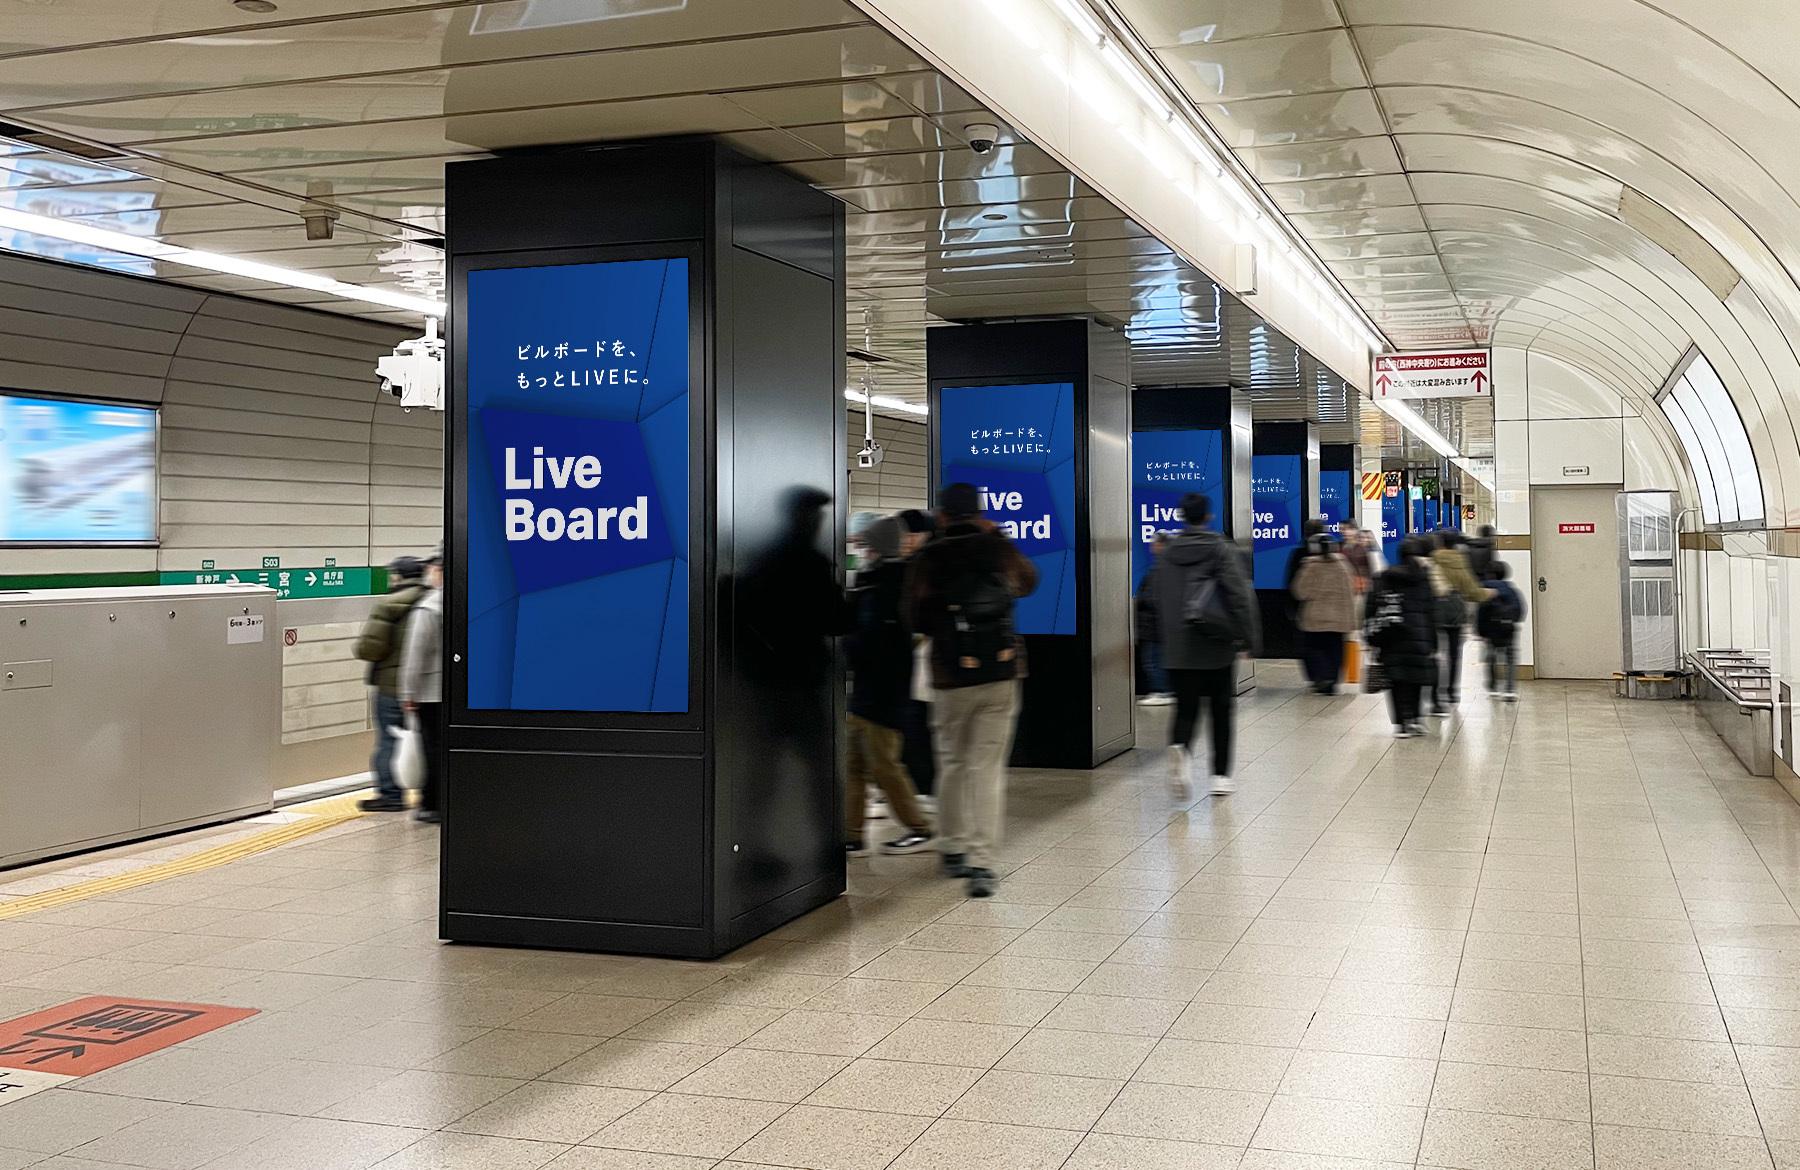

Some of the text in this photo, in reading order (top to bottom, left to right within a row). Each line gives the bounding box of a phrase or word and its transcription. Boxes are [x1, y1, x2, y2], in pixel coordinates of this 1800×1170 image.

[517, 339, 636, 361] ビルボードを、
[517, 368, 649, 389] もっとLIVEに。
[971, 427, 1043, 439] ビルボードを、
[970, 443, 1051, 455] もっとLIVEに。
[505, 446, 602, 490] Live
[977, 486, 1023, 511] ive
[505, 495, 648, 541] Board
[1000, 514, 1051, 540] ard
[1252, 510, 1274, 524] ive
[1252, 524, 1289, 539] oard
[263, 558, 279, 568] S03
